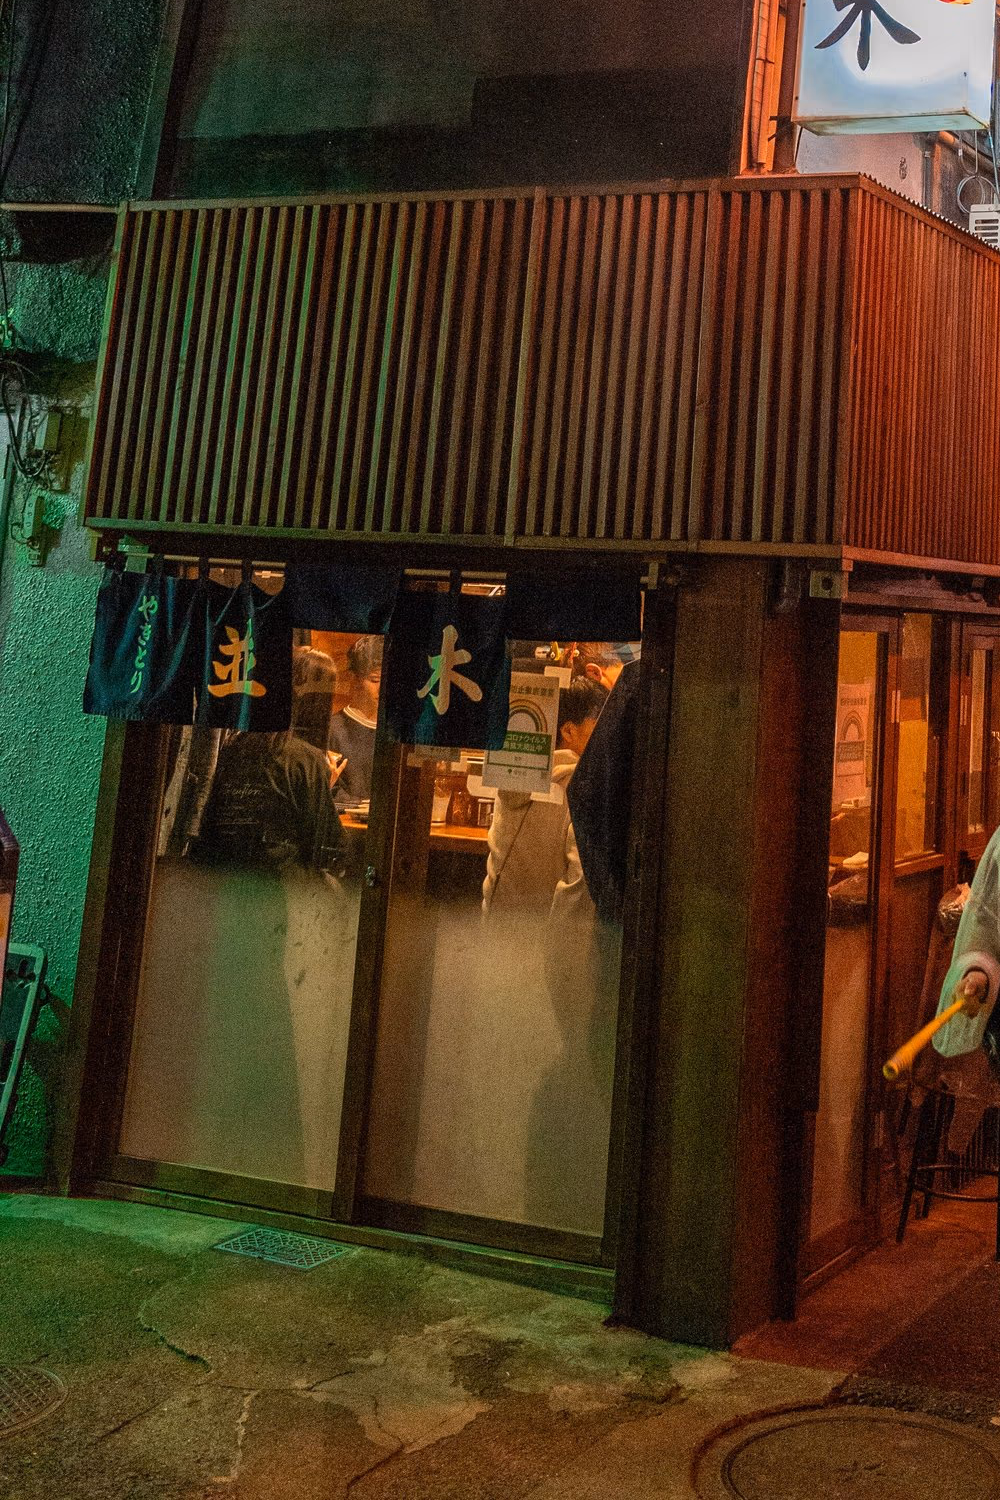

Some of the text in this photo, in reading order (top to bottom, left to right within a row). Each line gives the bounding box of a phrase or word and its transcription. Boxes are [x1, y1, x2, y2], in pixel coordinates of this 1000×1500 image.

[130, 595, 158, 694] やきとり
[208, 618, 483, 715] 並 木
